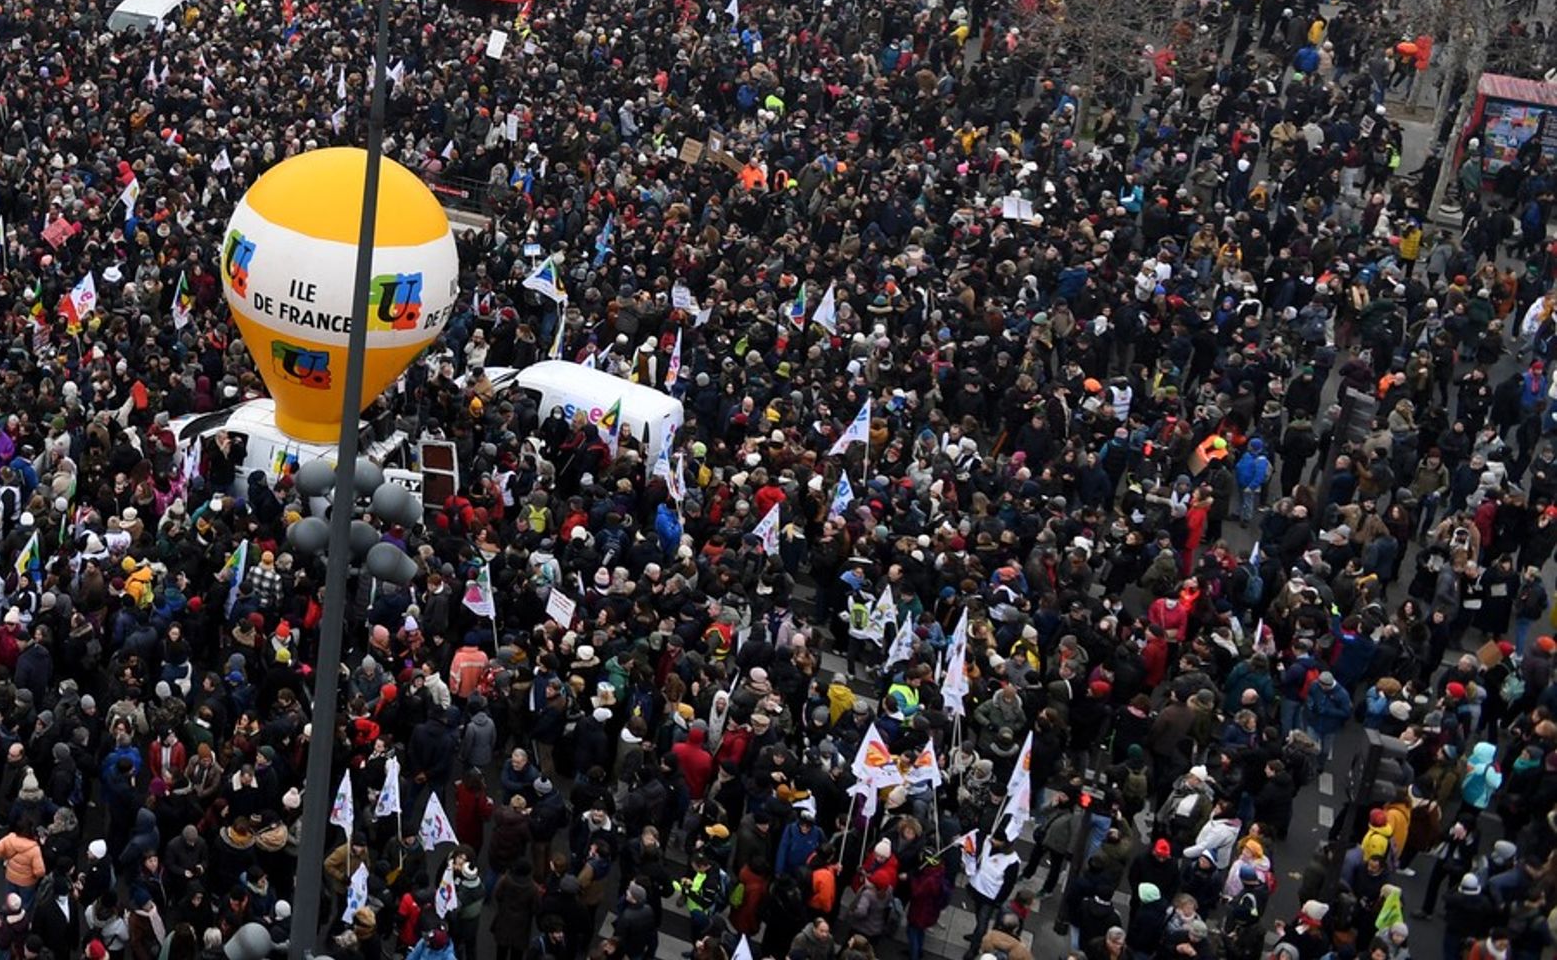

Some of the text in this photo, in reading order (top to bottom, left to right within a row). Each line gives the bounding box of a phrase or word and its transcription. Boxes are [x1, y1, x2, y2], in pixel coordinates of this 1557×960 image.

[289, 279, 317, 304] ILE
[254, 293, 352, 335] DE FRANCE
